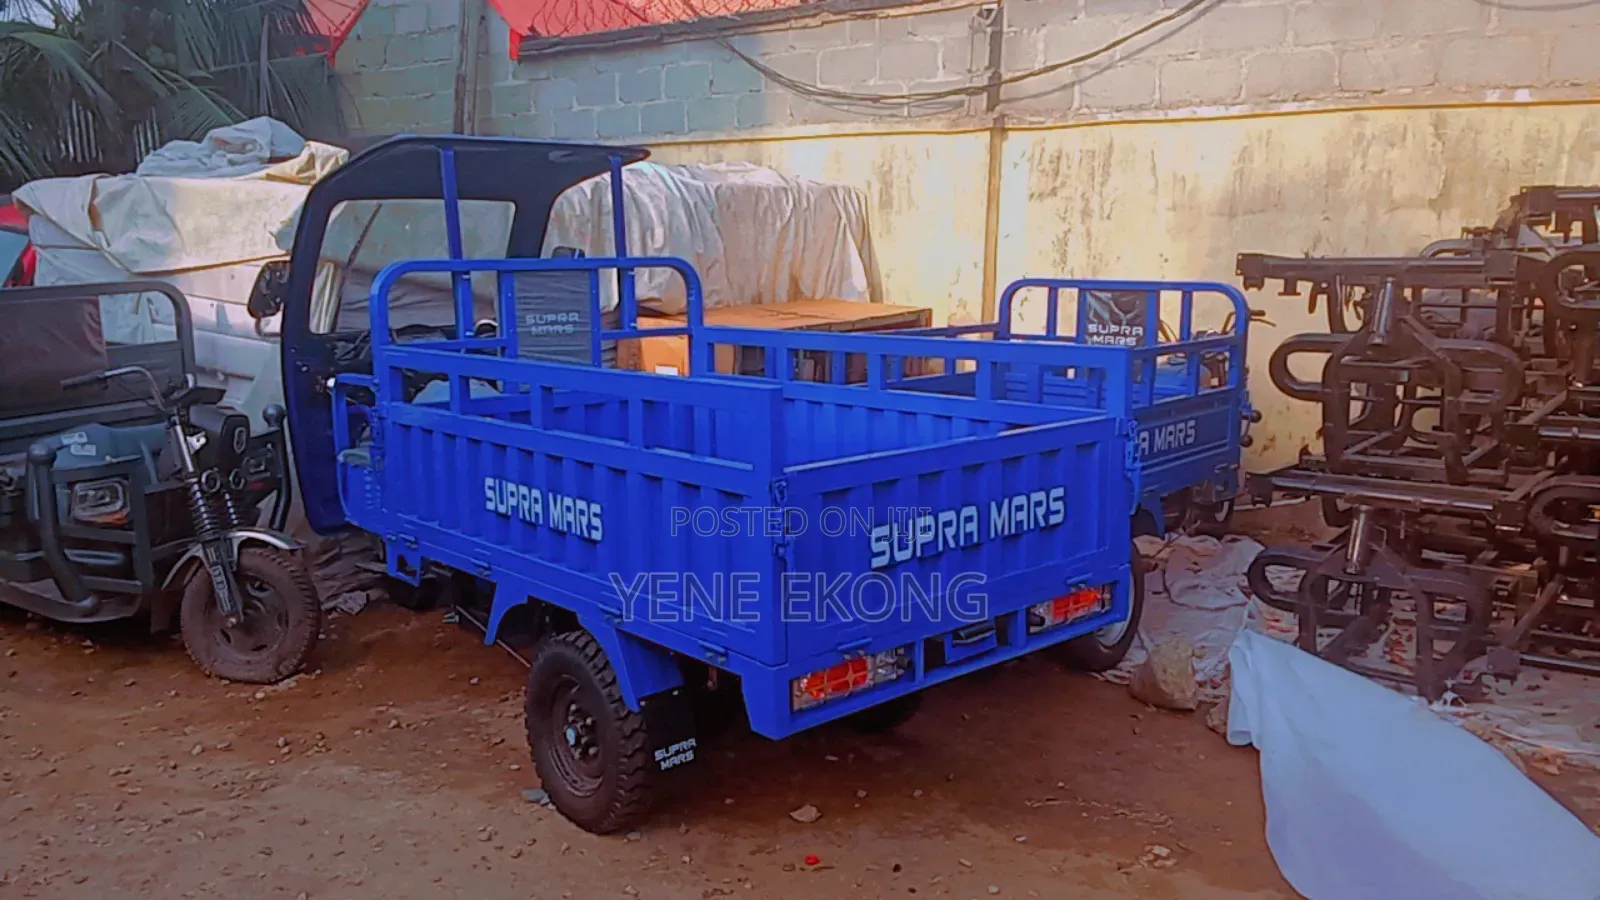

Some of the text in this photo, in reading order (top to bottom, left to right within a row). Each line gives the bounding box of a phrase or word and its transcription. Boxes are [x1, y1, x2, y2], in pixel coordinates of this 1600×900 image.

[525, 312, 580, 325] SUPRA
[1087, 323, 1144, 337] SUPRA
[1093, 334, 1138, 346] MARS
[1153, 419, 1196, 454] MARS
[484, 477, 603, 541] SUPRA MARS
[870, 487, 1065, 569] SUPRA MARS
[654, 738, 697, 761] SUPRA
[660, 750, 694, 770] MARS
